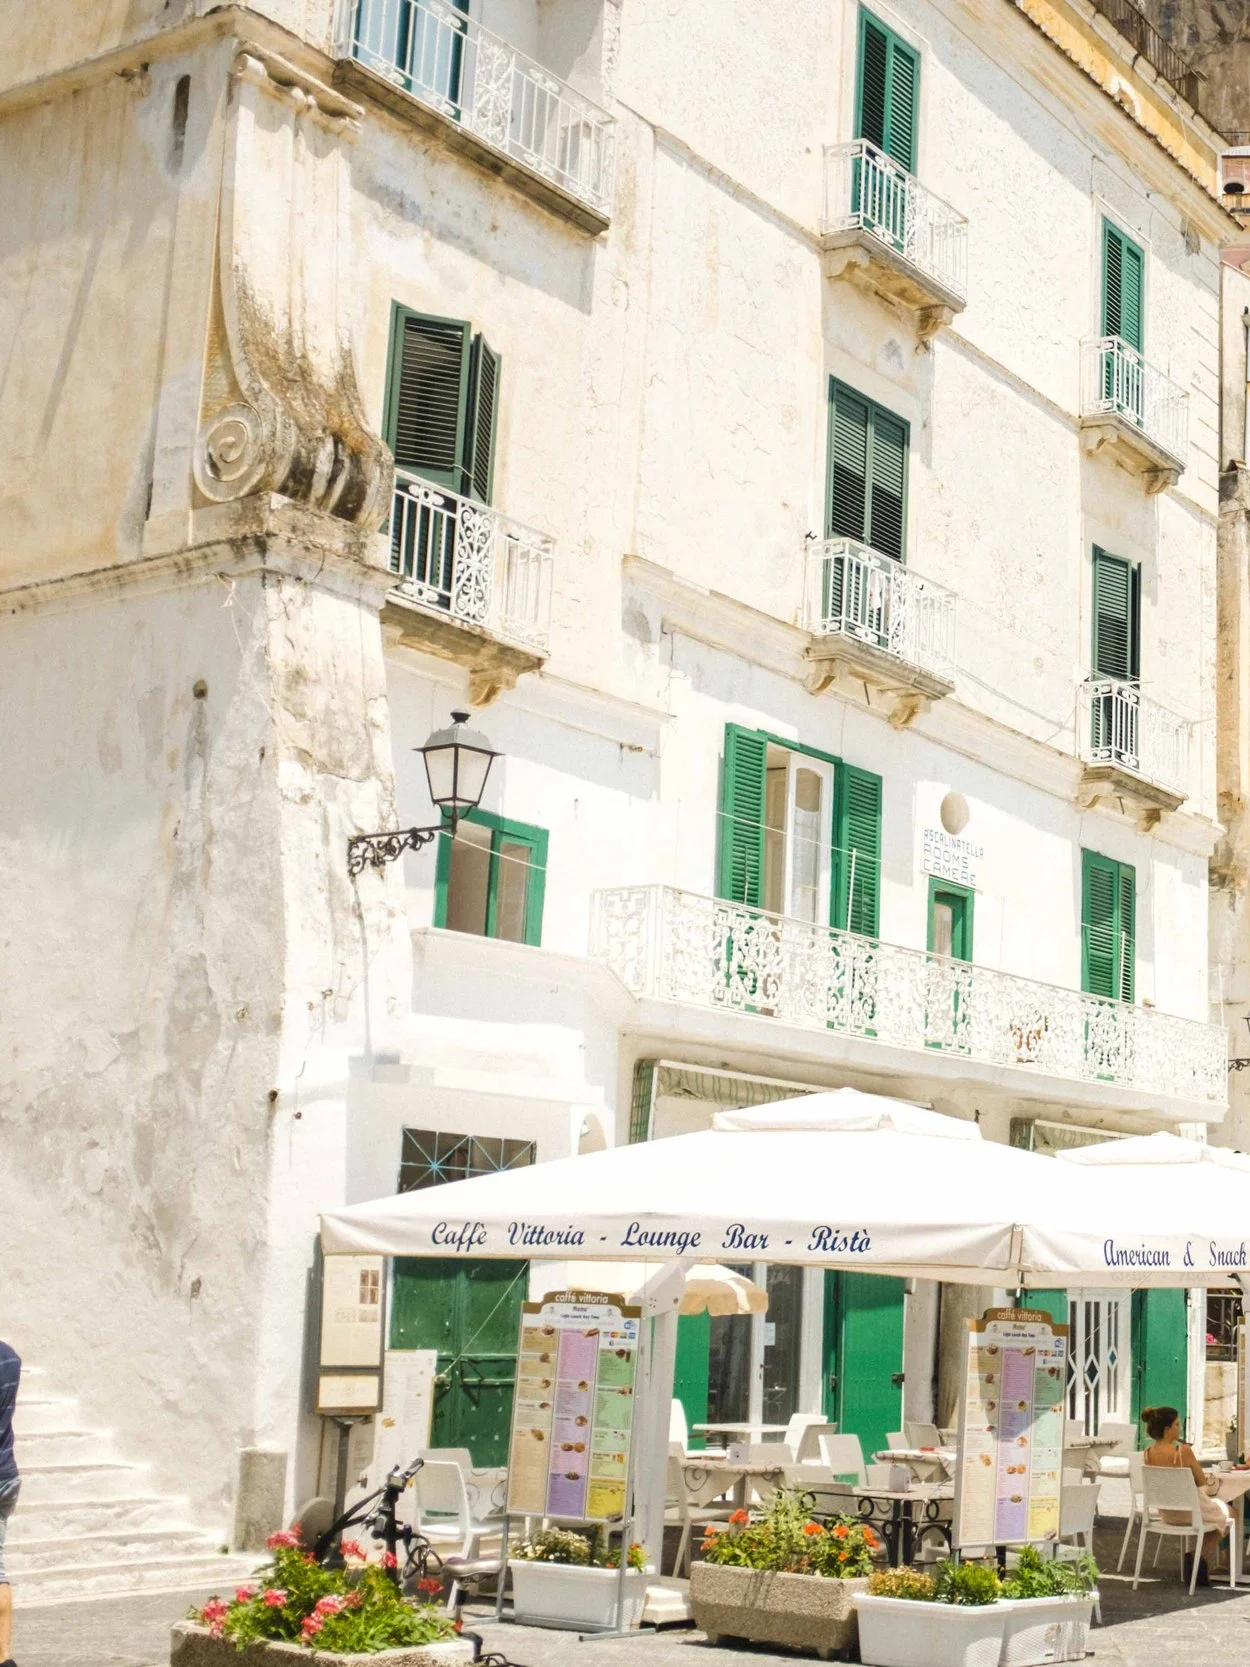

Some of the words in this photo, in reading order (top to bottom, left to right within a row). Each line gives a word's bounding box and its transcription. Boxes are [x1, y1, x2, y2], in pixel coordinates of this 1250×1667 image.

[923, 843, 969, 869] ROOMS
[923, 858, 977, 887] CAMERE
[431, 1222, 487, 1253] Caffè
[508, 1222, 584, 1246] Vittoria
[621, 1222, 702, 1255] Lounge
[722, 1224, 769, 1250] Bar
[808, 1226, 872, 1253] Ristò
[1103, 1239, 1170, 1267] American
[1183, 1241, 1195, 1267] &
[1209, 1240, 1247, 1267] Snack
[578, 1292, 609, 1304] vittoria
[1017, 1310, 1042, 1321] vittoria
